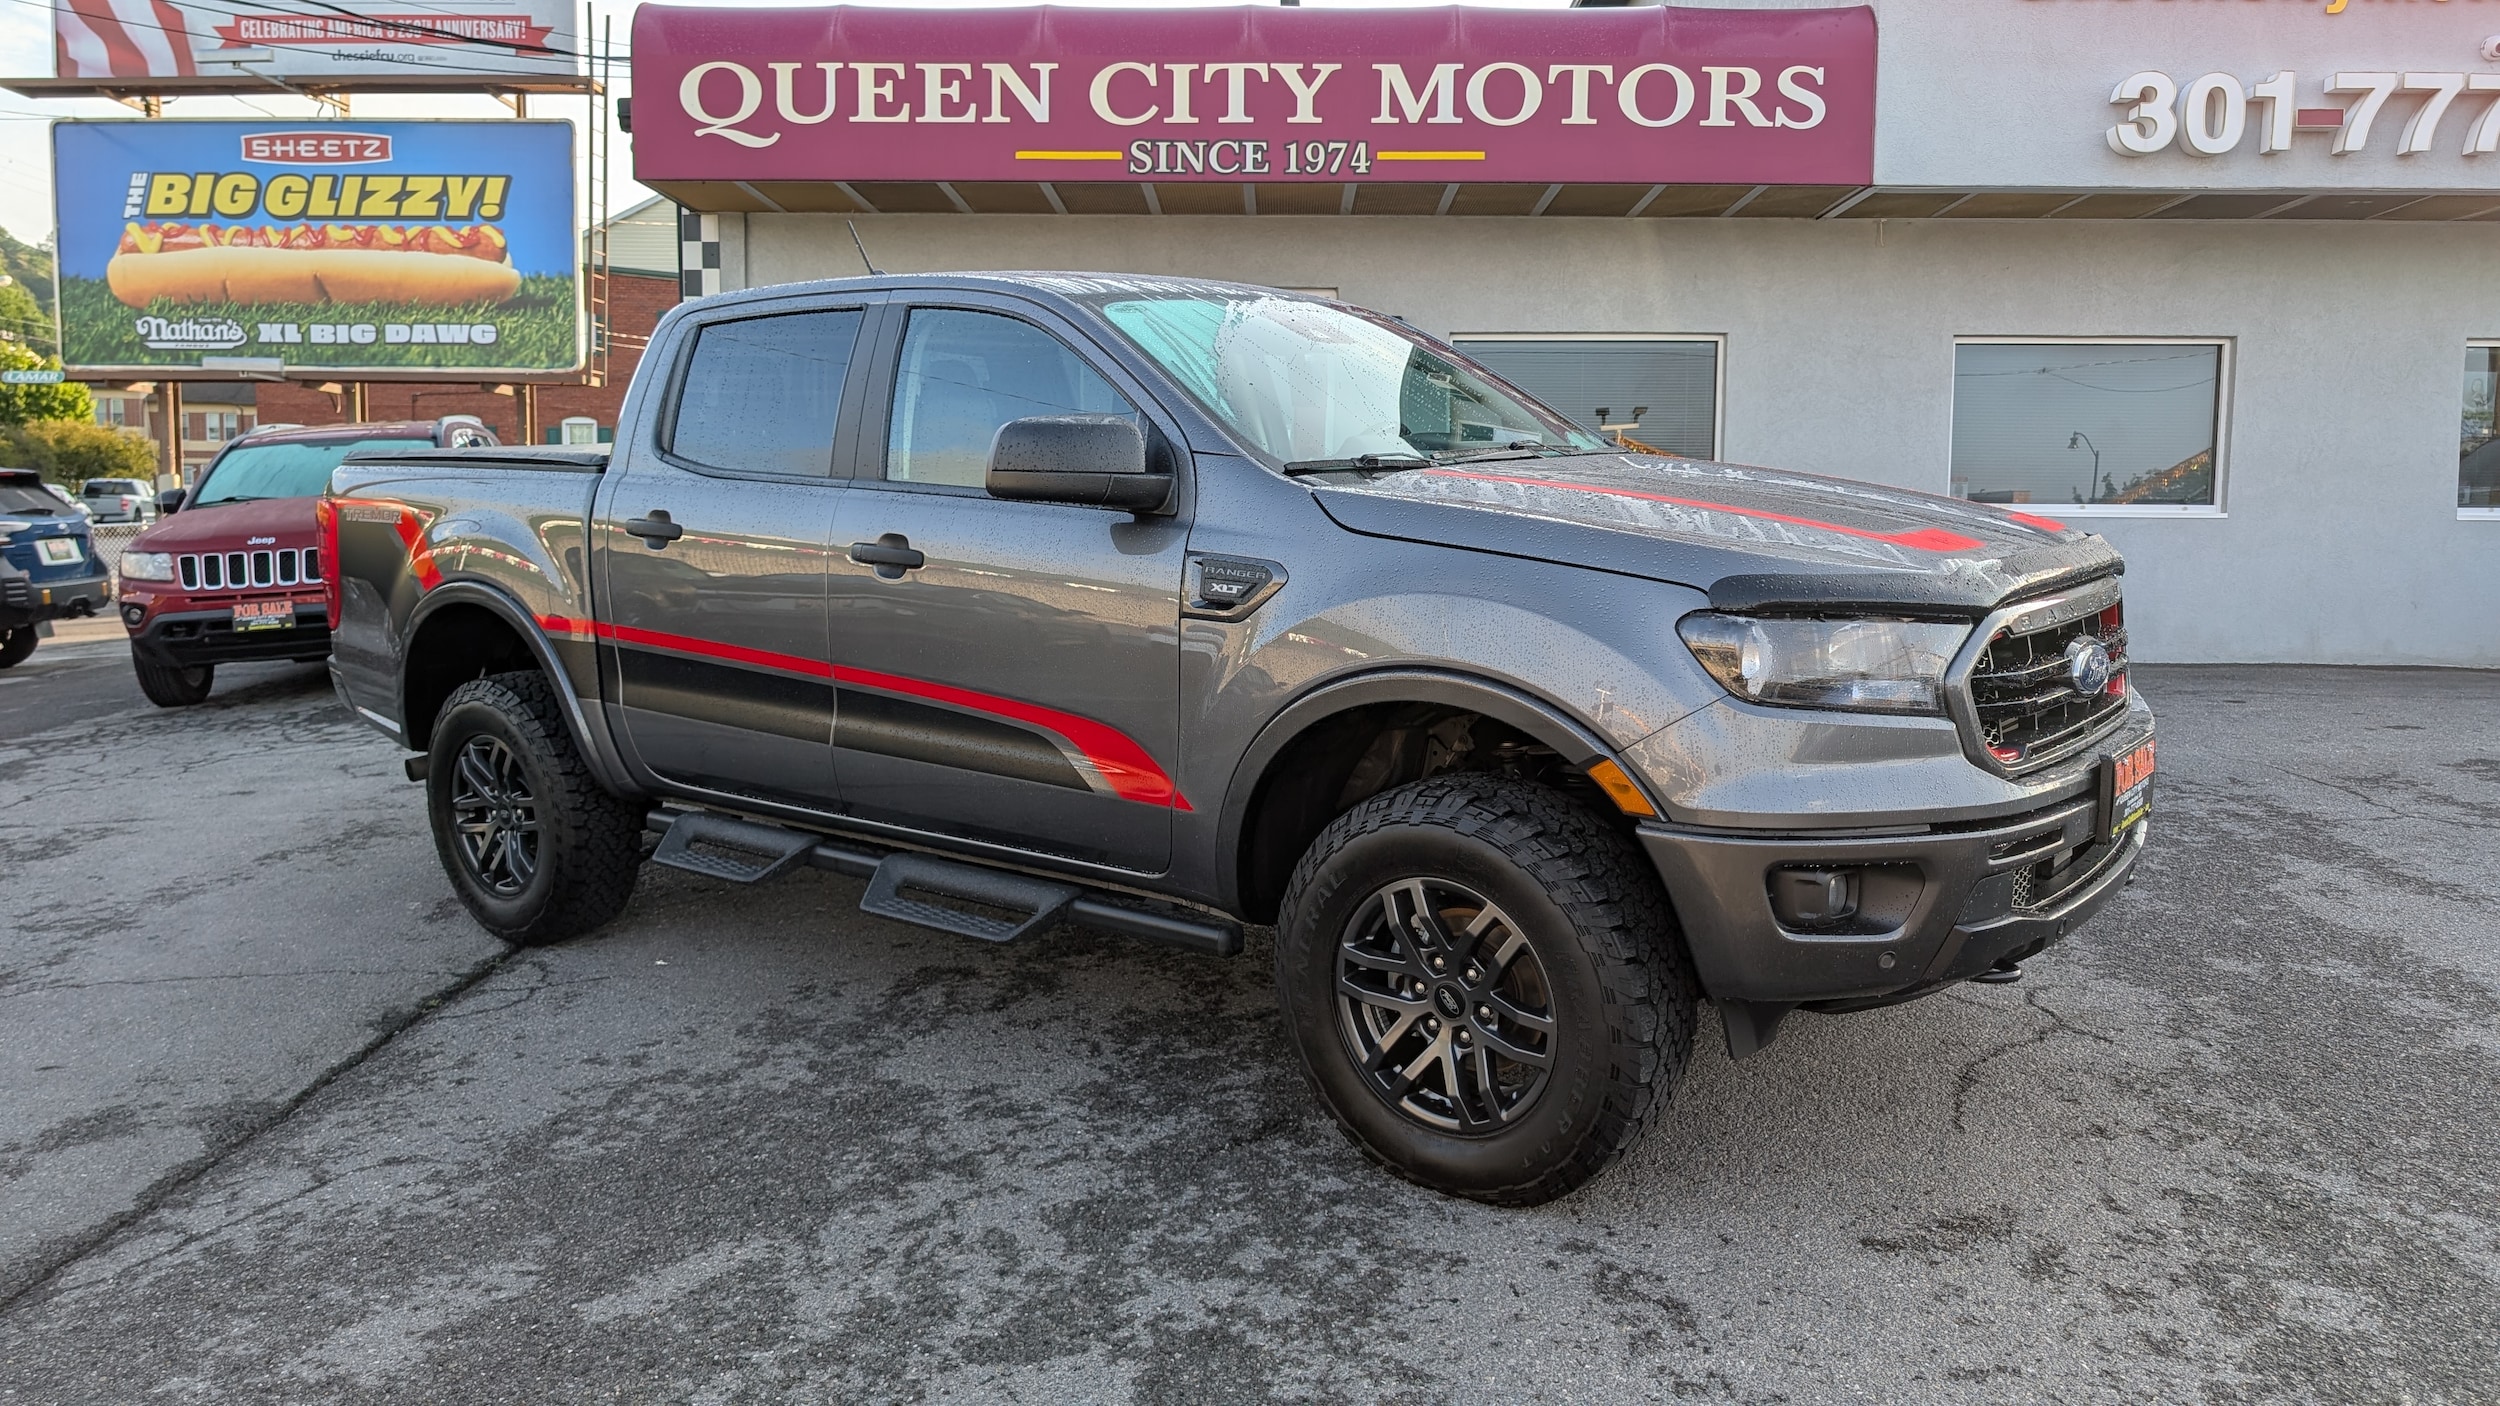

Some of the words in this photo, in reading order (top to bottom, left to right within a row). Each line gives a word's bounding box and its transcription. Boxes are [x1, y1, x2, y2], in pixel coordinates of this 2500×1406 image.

[240, 19, 324, 39] CELEBRATING
[327, 18, 395, 39] AMERICAS
[434, 19, 526, 39] ANNIVERSARY!
[332, 49, 415, 63] chessiefcu.org
[679, 61, 1058, 149] QUEEN
[1088, 61, 1342, 127] CITY
[1371, 62, 1826, 130] MOTORS
[252, 139, 381, 158] SHEETZ
[1128, 139, 1270, 175] SINCE
[1284, 140, 1372, 175] 1974
[123, 172, 148, 219] THE
[145, 172, 260, 219] BIG
[263, 173, 511, 221] GLIZZY!
[135, 316, 246, 342] Nathan's
[257, 323, 302, 343] XL
[310, 324, 377, 344] BIG
[385, 324, 497, 344] DAWG
[7, 372, 59, 381] LAMAR
[247, 536, 276, 545] Jeep
[1205, 566, 1266, 579] RANGER
[1211, 582, 1243, 594] XLT
[233, 604, 260, 618] FOR
[262, 601, 293, 615] SALE
